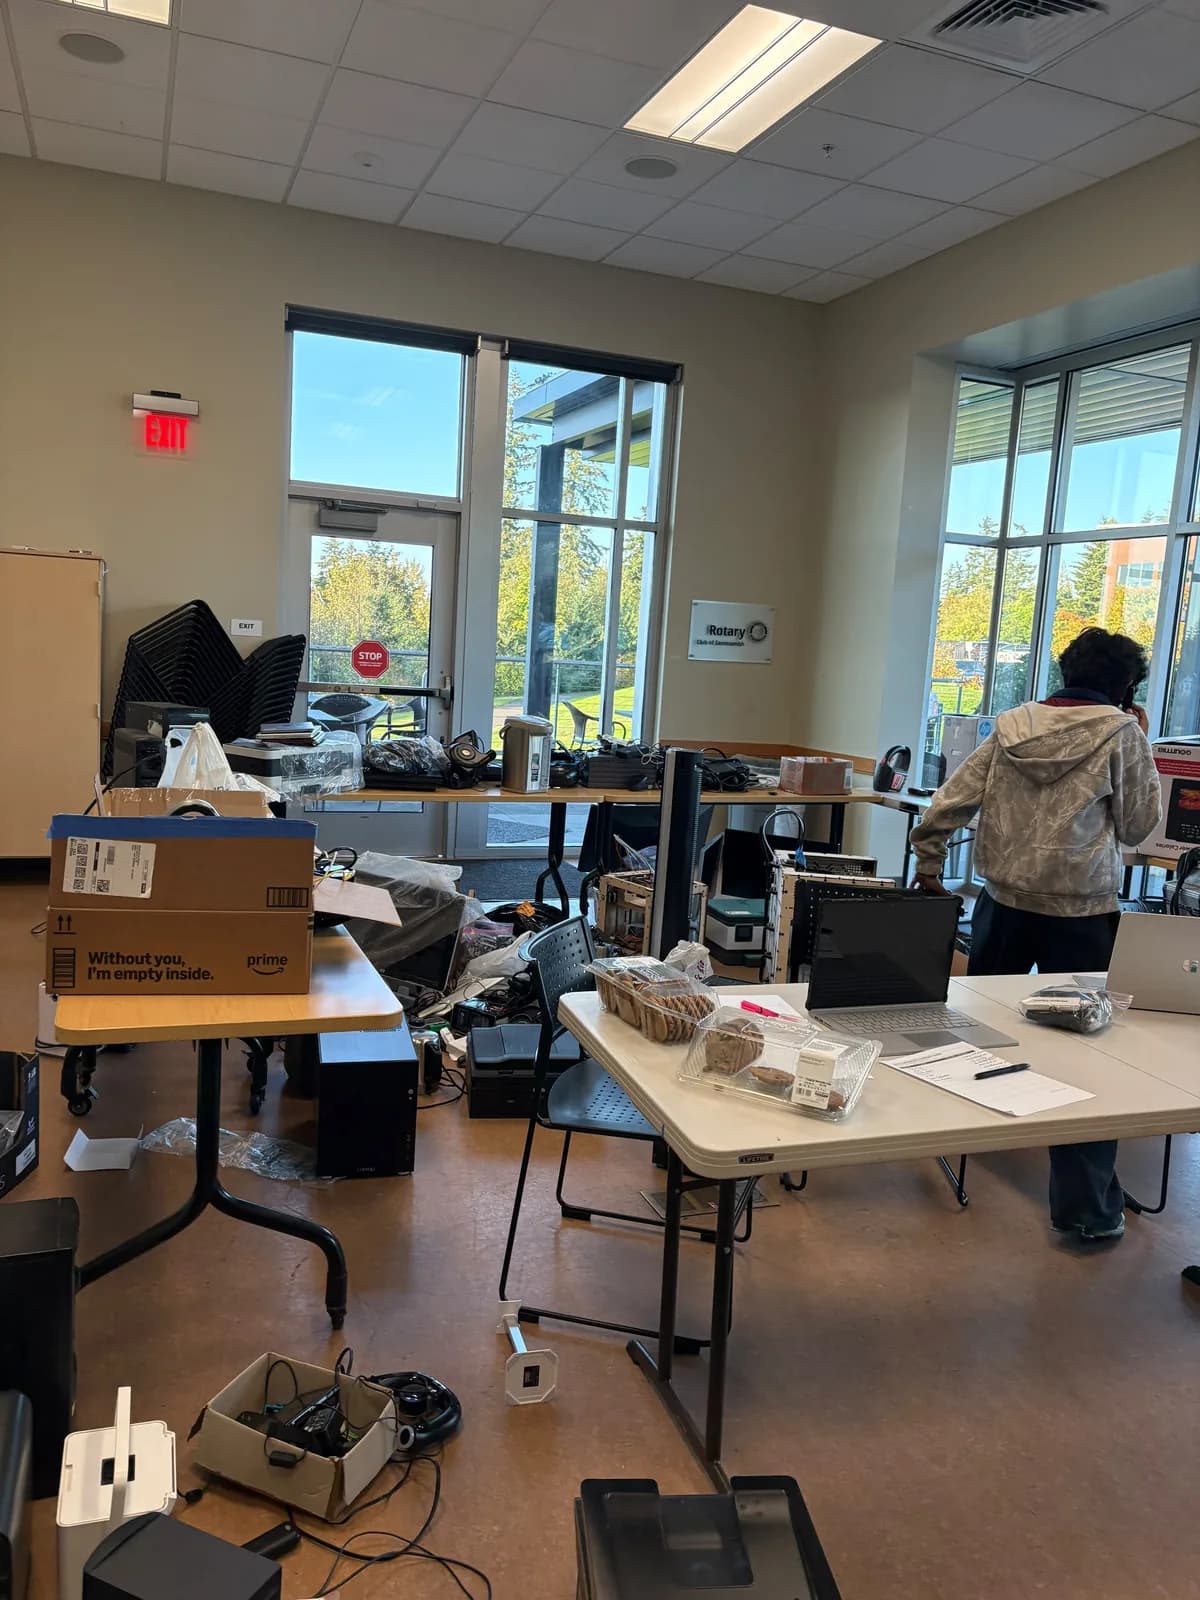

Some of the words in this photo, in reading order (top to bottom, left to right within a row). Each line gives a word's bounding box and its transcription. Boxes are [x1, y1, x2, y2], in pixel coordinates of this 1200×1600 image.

[145, 415, 188, 449] EXIT
[709, 624, 746, 640] Rotary
[358, 651, 382, 660] STOP
[88, 951, 152, 965] Without
[154, 953, 185, 967] you,
[247, 953, 288, 968] prime
[88, 967, 111, 980] I'm
[114, 967, 163, 982] empty
[166, 968, 214, 981] inside.
